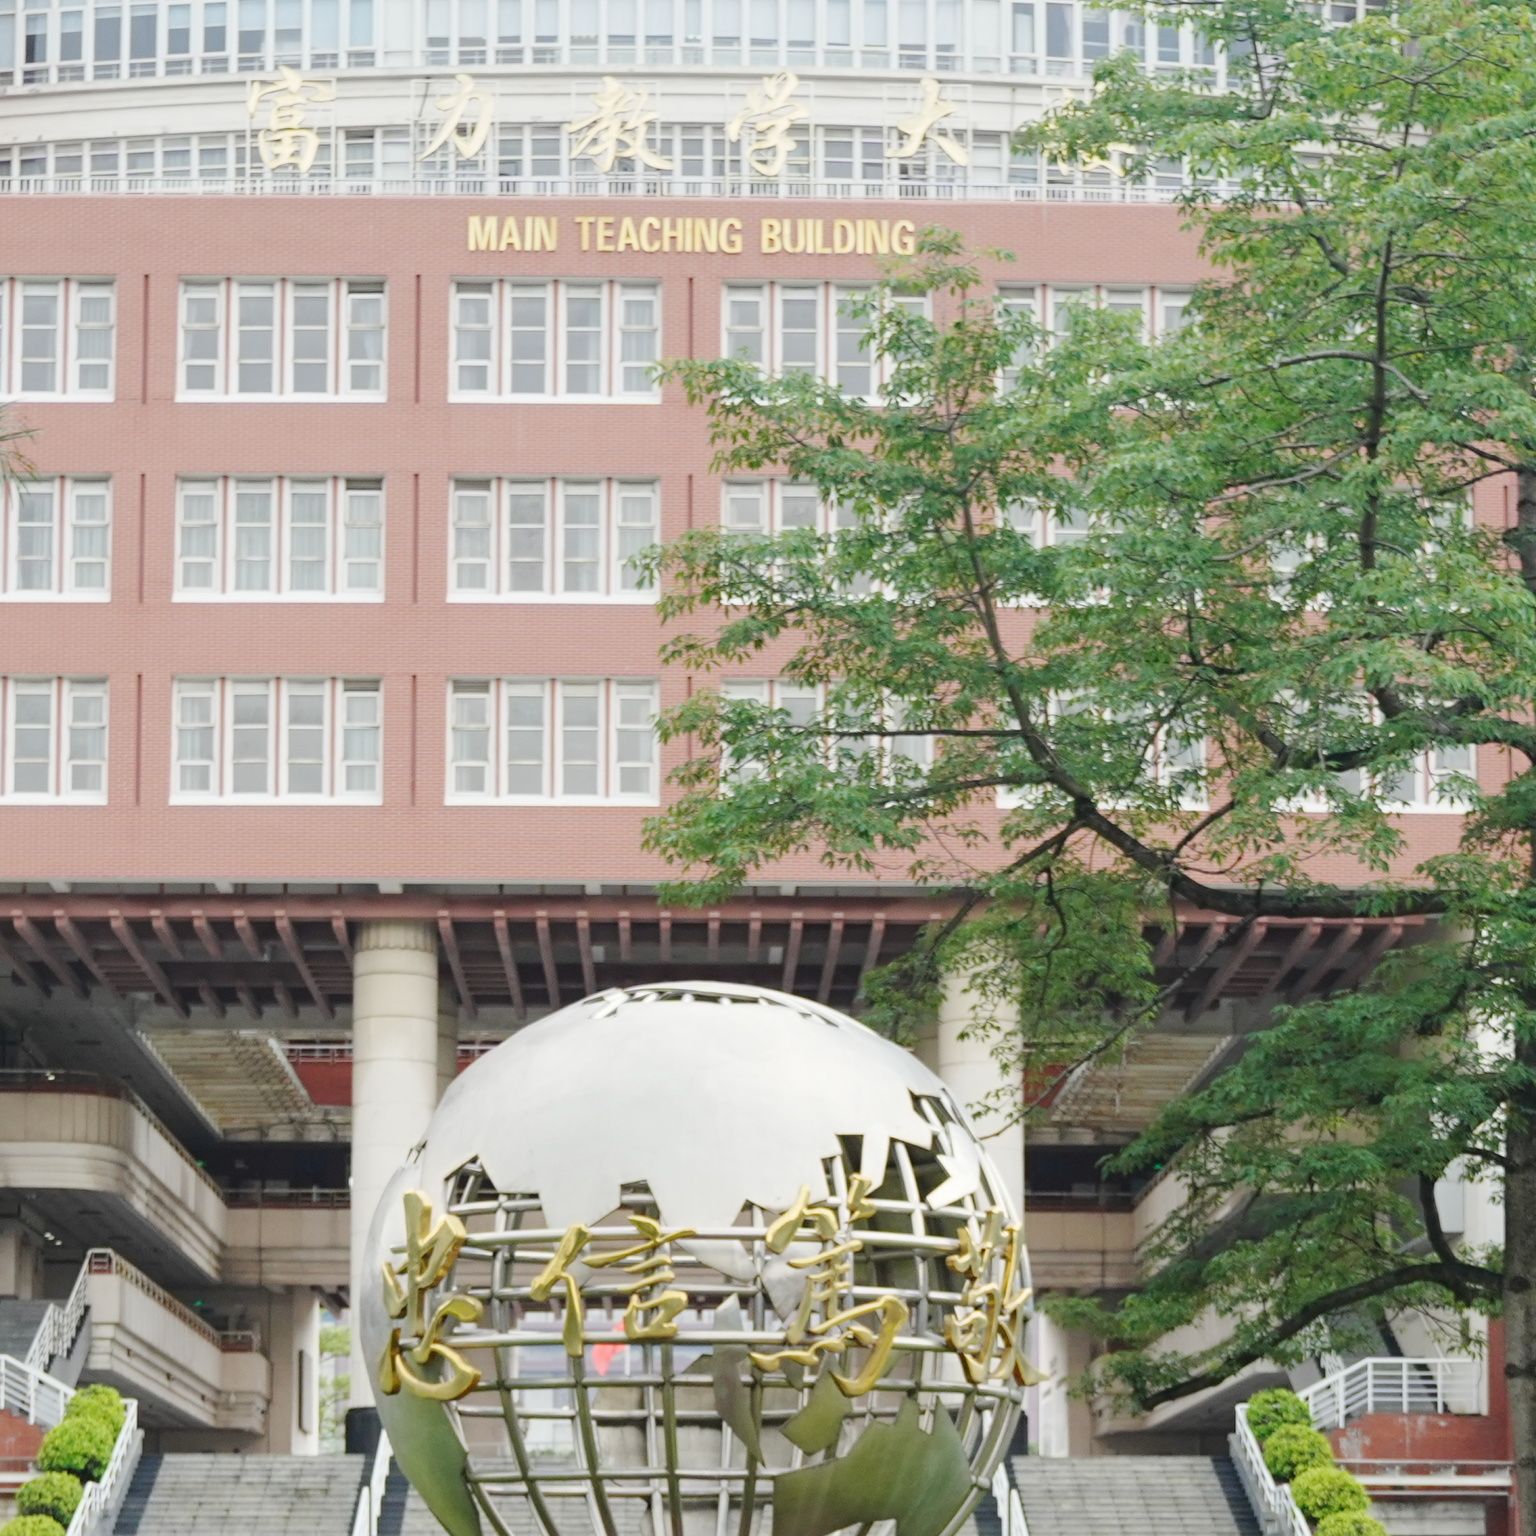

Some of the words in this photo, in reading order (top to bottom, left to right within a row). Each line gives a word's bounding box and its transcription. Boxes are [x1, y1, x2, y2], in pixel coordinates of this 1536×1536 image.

[466, 214, 558, 252] MAIN
[575, 215, 743, 254] TEACHING
[761, 217, 916, 255] BUILDING
